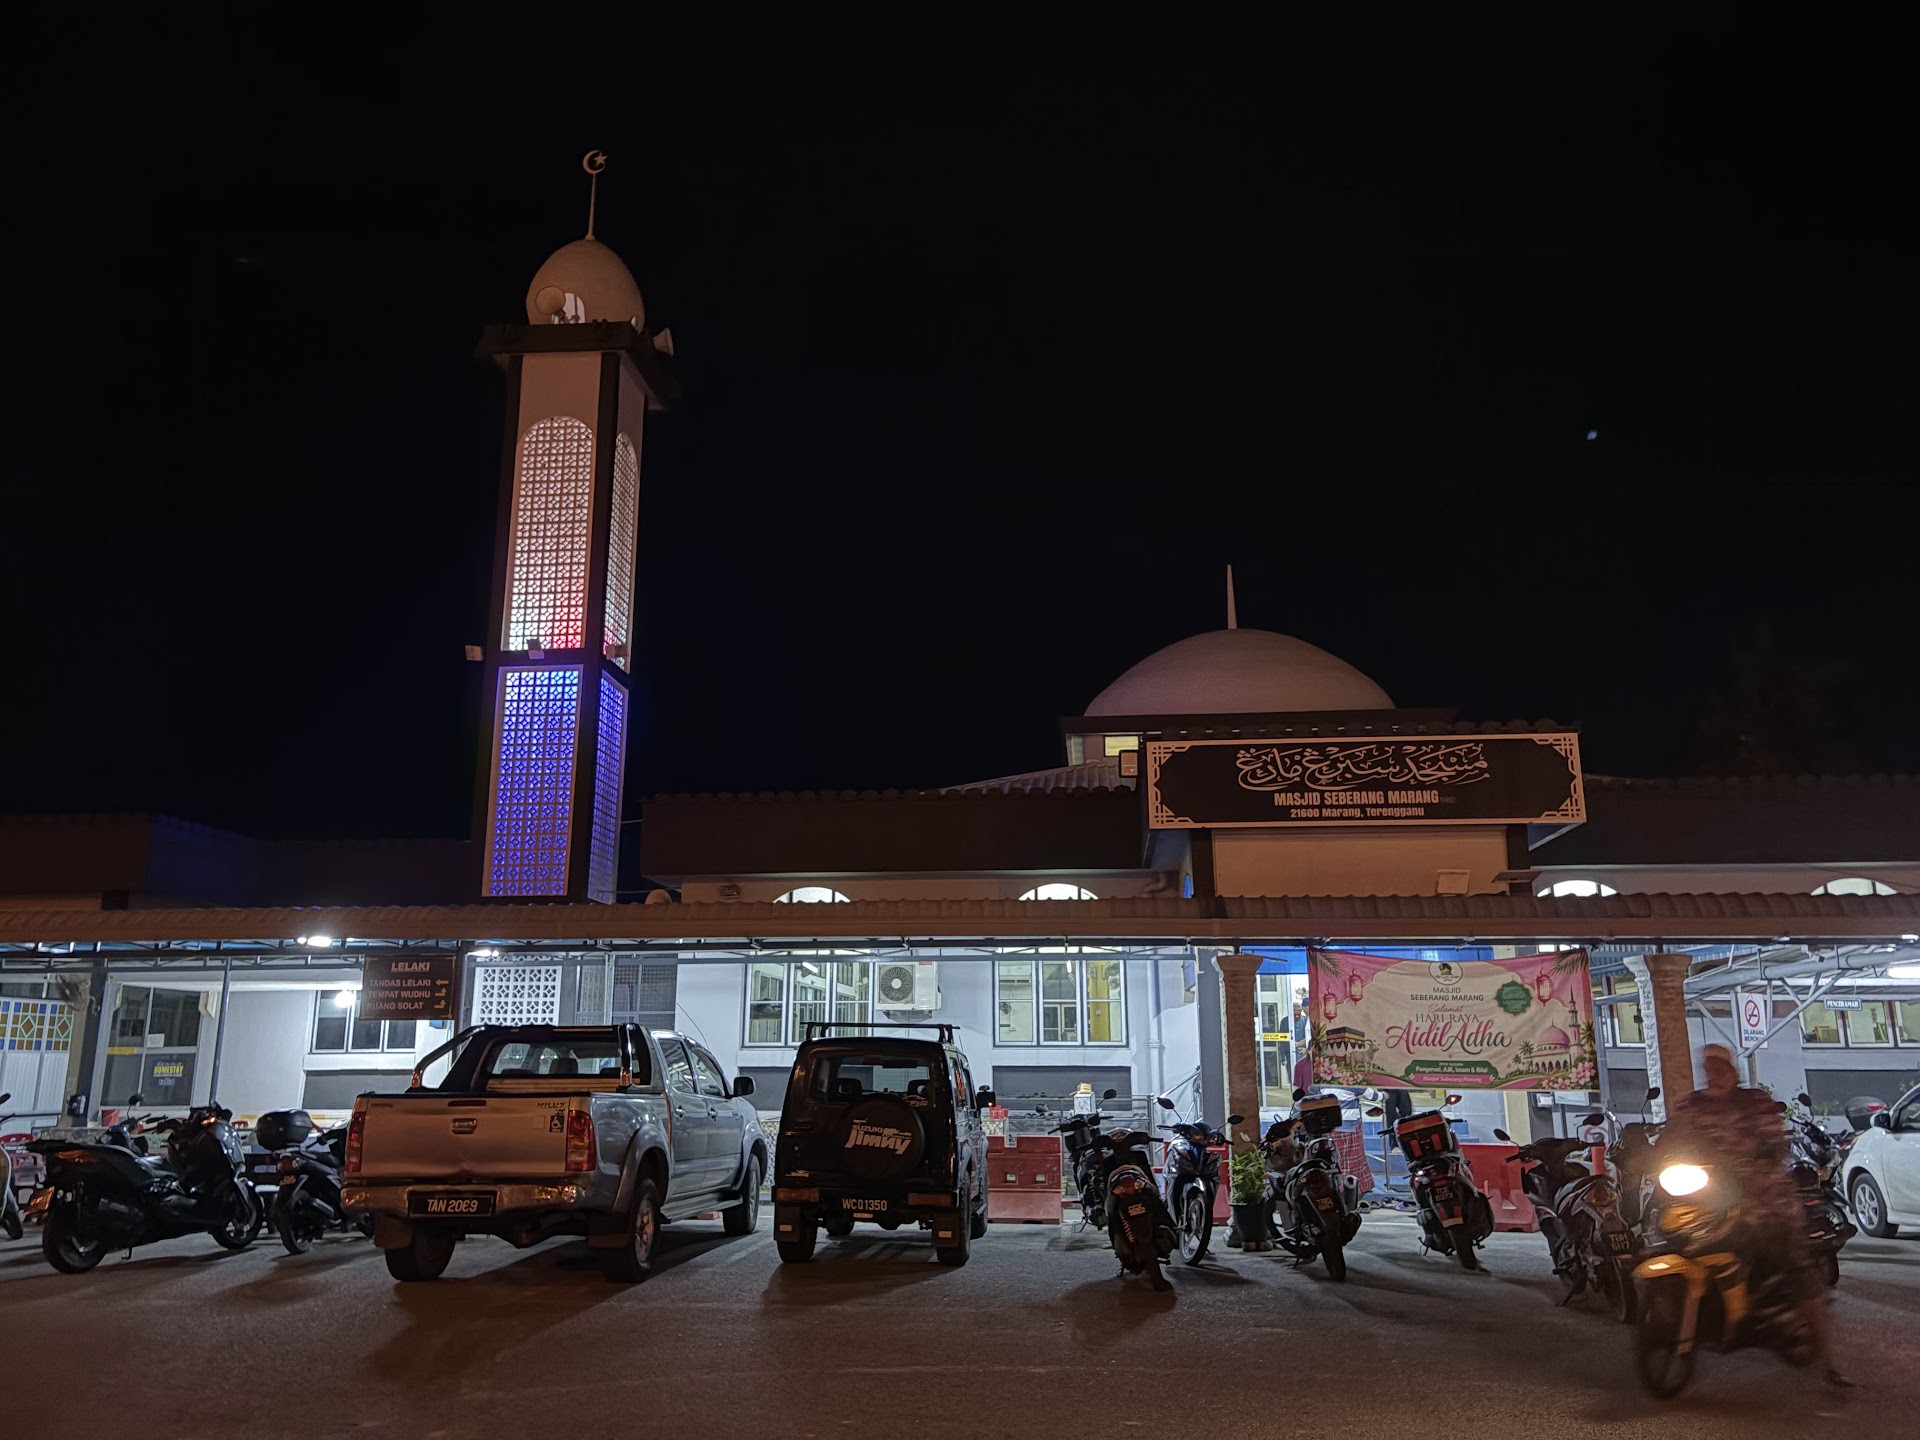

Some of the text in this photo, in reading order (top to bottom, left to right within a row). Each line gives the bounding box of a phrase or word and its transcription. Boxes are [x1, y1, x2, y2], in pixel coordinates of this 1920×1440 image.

[1274, 792, 1321, 806] MASJID
[1323, 791, 1385, 805] SEBERANG
[1388, 790, 1440, 804] MARANG
[1290, 806, 1425, 818] 21600 Marang, Terengganu
[391, 962, 431, 972] LELAKI
[370, 979, 431, 987] TANDAS LELAKI
[368, 990, 431, 999] TEMPAT WUDHU
[367, 1001, 424, 1010] RUANG SOLAT
[1428, 1003, 1464, 1014] Selamat
[1826, 1000, 1859, 1008] PENCERAMAH
[1415, 1013, 1480, 1023] HARI RAYA
[1743, 1028, 1765, 1036] DILARANG
[153, 1065, 184, 1075] HOMESTAY
[852, 1124, 883, 1134] SUZUKI
[427, 1199, 448, 1213] TAN
